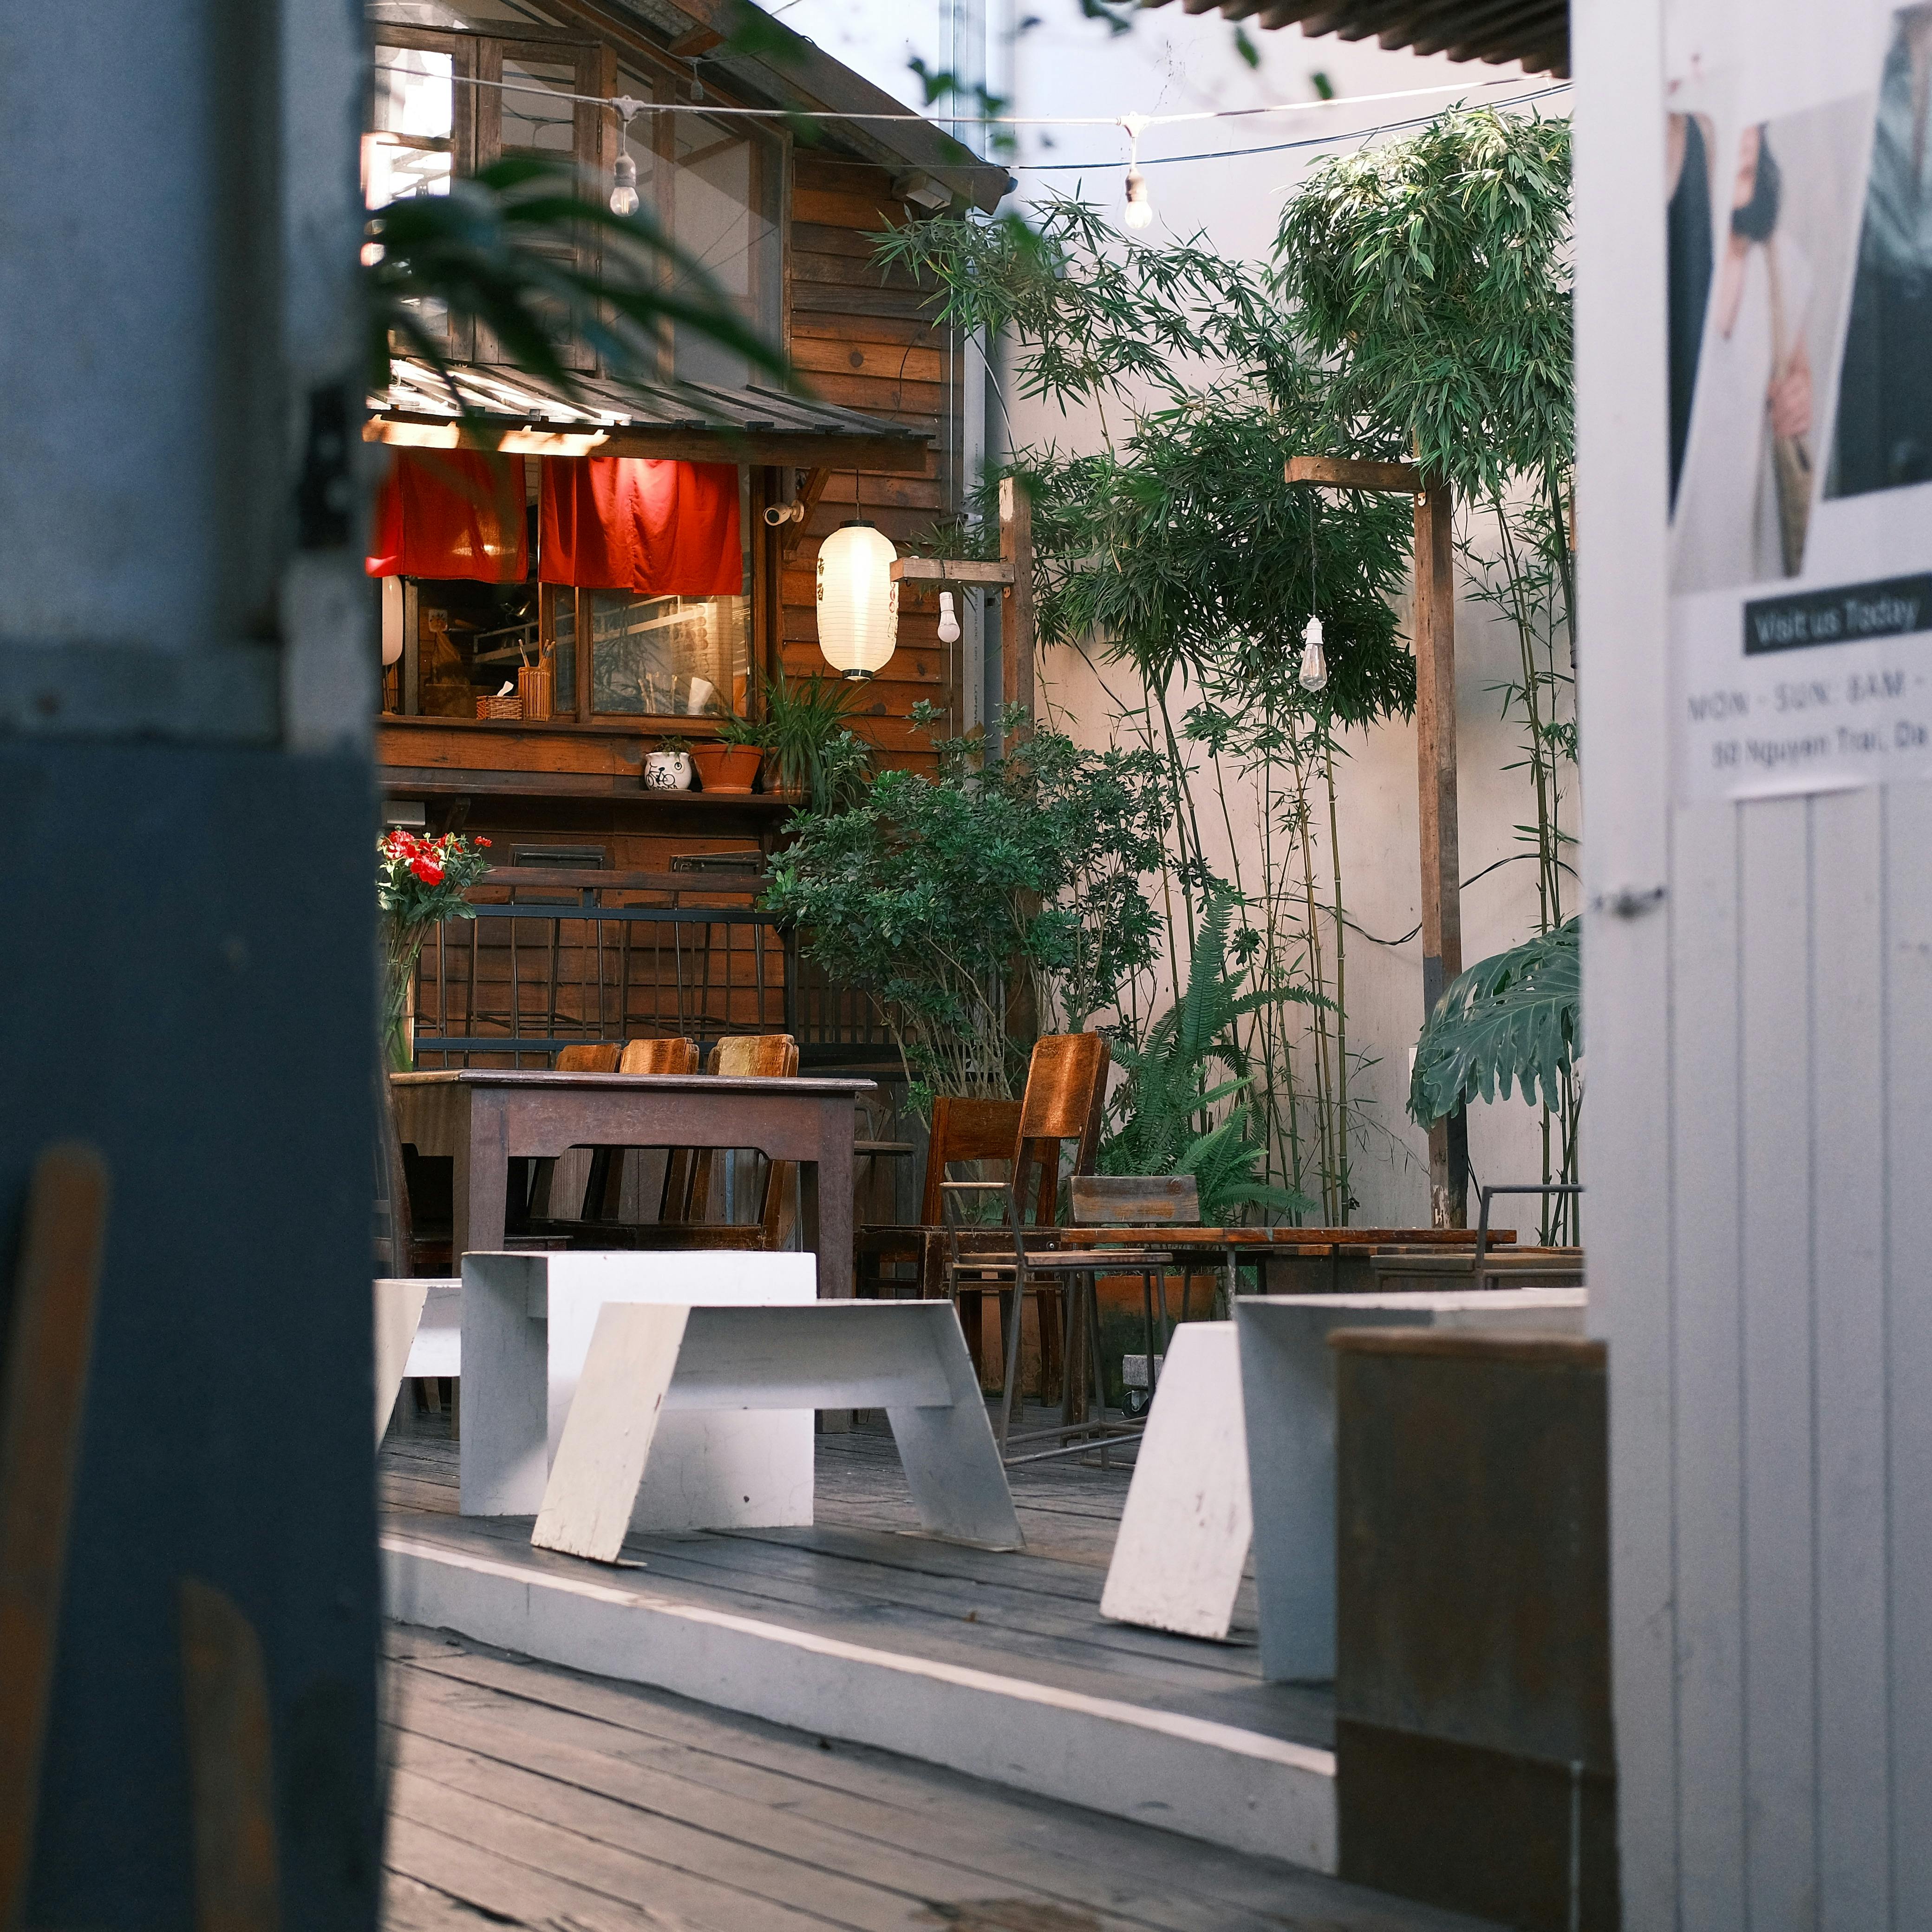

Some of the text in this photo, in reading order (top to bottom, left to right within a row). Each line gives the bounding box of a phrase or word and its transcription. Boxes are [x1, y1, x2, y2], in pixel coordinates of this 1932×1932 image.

[1754, 594, 1919, 645] Visit us Today
[1687, 690, 1749, 723] MON
[1744, 734, 1829, 770] Nguyen
